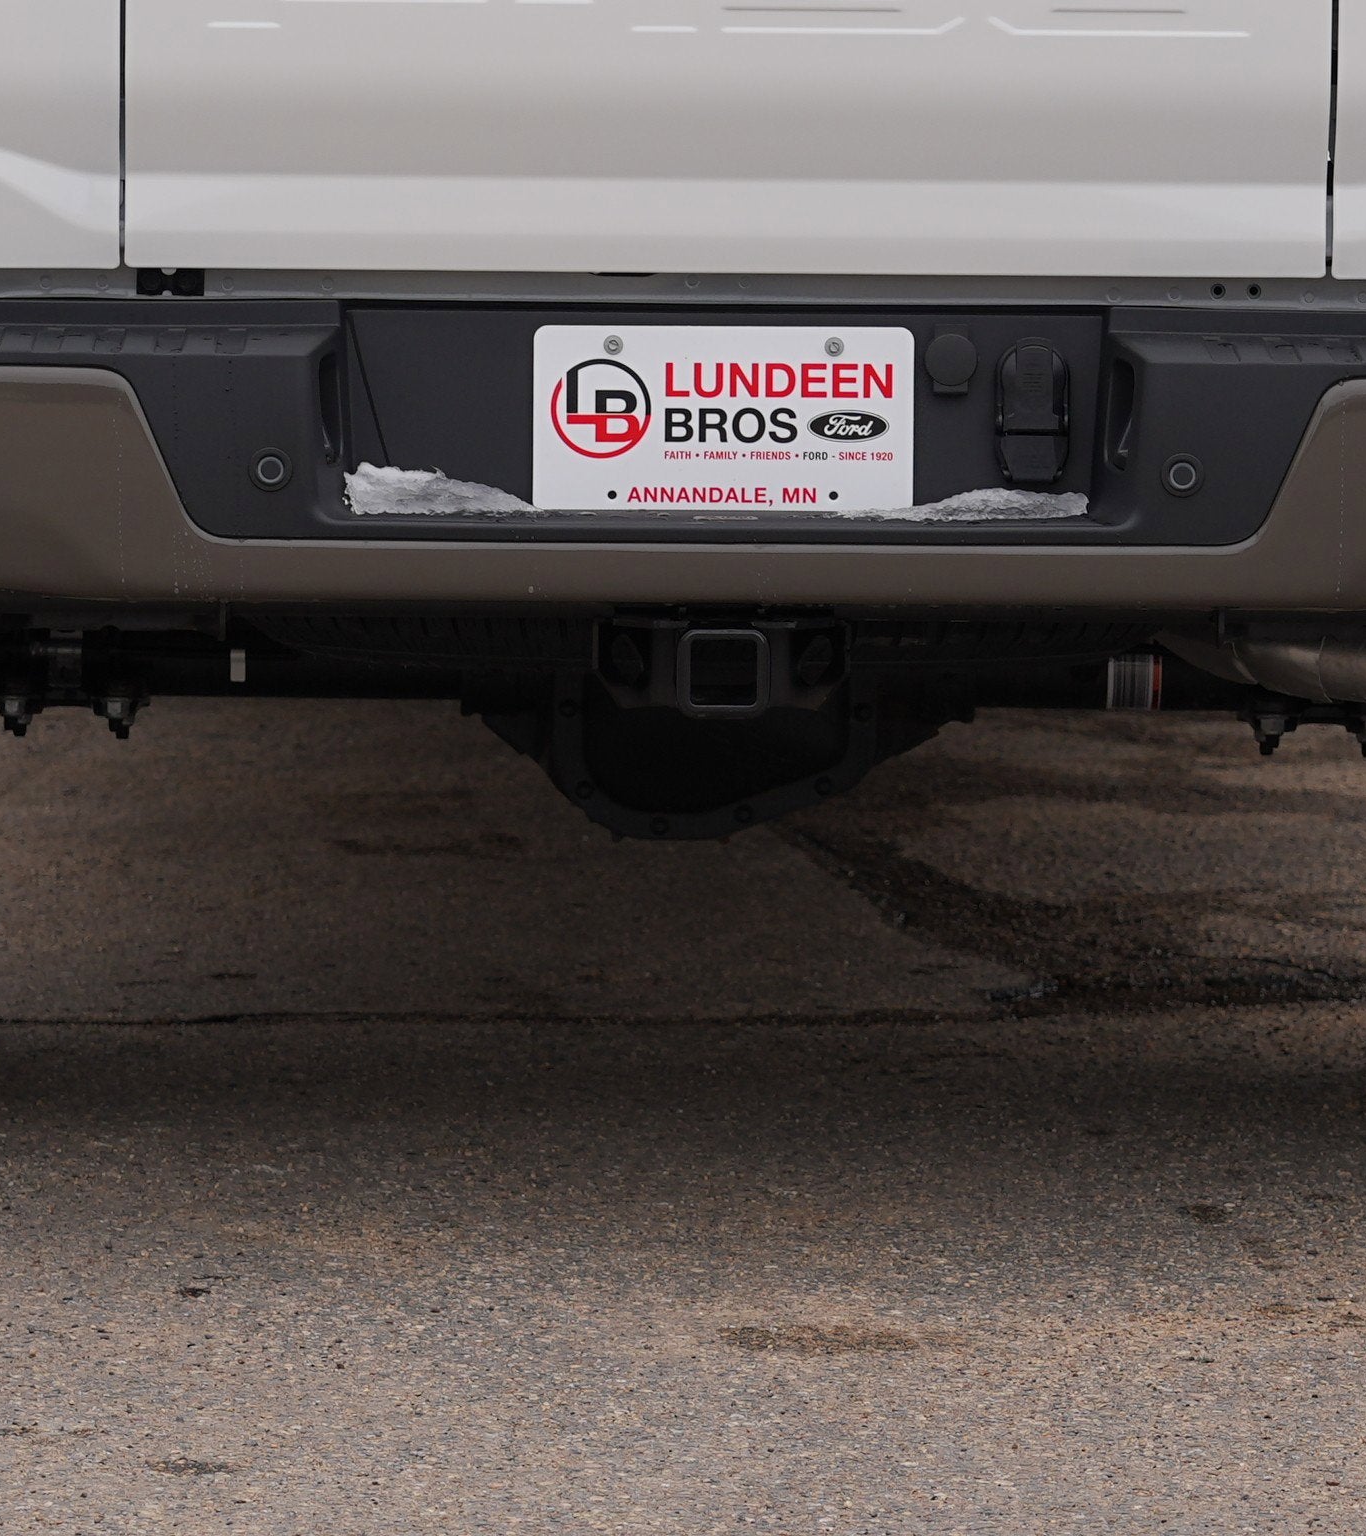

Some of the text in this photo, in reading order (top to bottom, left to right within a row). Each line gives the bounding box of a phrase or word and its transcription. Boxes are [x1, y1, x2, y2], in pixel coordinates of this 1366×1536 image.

[664, 362, 893, 399] LUNDEEN
[664, 407, 874, 444] BROS Ford
[664, 450, 894, 462] FAITH FAMILY FRIENDS FORD SINCE 1920
[626, 486, 817, 506] ANNANDALE, MN
